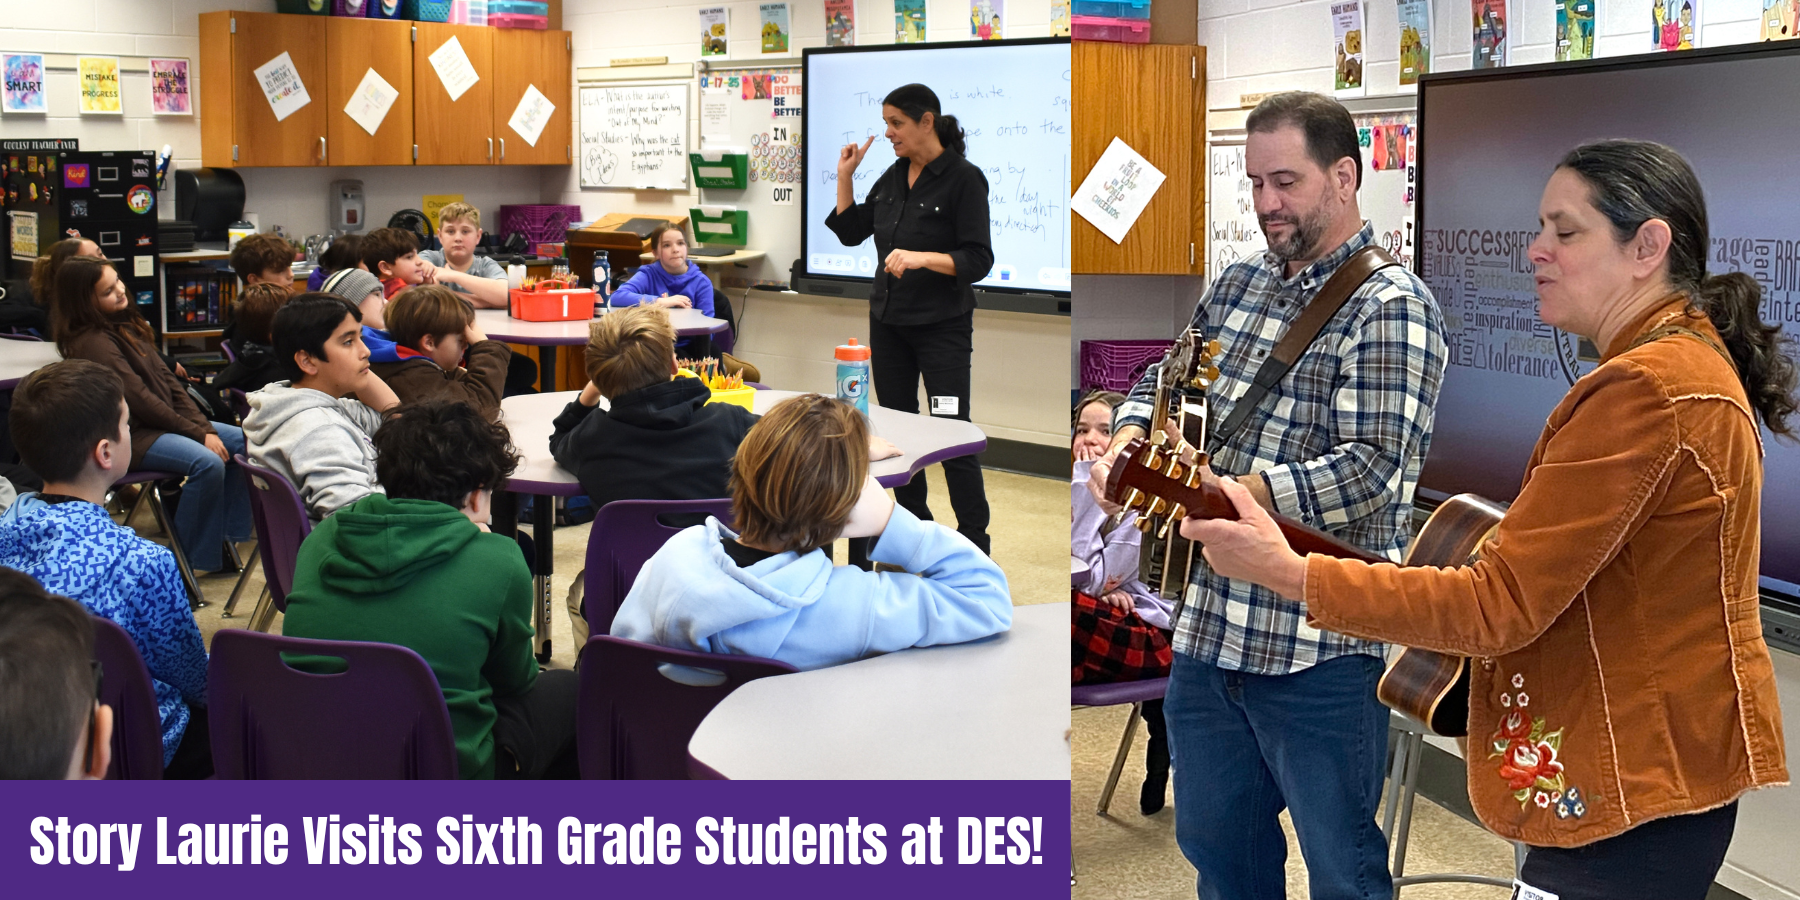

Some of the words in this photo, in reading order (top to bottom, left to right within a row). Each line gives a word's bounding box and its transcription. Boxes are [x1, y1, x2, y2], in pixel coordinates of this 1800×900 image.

[6, 81, 41, 91] SMART
[774, 86, 802, 95] BETTE
[606, 88, 623, 103] What
[633, 90, 643, 100] the
[774, 97, 785, 106] BE
[950, 89, 959, 100] is
[662, 104, 681, 116] writing
[774, 107, 802, 116] BETTE
[624, 117, 630, 126] of
[997, 120, 1028, 136] onto
[1040, 118, 1065, 134] the
[582, 132, 599, 144] Social
[601, 131, 623, 144] Studies
[631, 132, 645, 151] Why
[660, 134, 668, 144] the
[671, 133, 680, 144] cat
[774, 127, 786, 141] IN
[3, 141, 30, 150] COOLEST
[32, 141, 59, 150] TEACHER
[60, 141, 77, 150] EVER
[590, 154, 602, 167] Big
[639, 149, 664, 160] important
[598, 160, 614, 176] Ideas
[1127, 159, 1137, 170] BE
[1214, 153, 1230, 176] ELA
[67, 168, 86, 178] Kind
[1119, 164, 1140, 182] FRUIT
[1008, 162, 1025, 201] by
[1121, 176, 1137, 190] LOOP
[774, 188, 792, 201] OUT
[1104, 181, 1124, 201] WORLD
[1092, 194, 1120, 220] CHEERIOS
[1212, 221, 1229, 242] Social
[1230, 220, 1253, 242] Studies
[1437, 229, 1511, 257] success
[1707, 237, 1754, 273] rage
[562, 295, 568, 317] 1
[1478, 296, 1533, 310] accomplishment
[1769, 290, 1800, 323] Inte
[1463, 256, 1479, 367] dedication
[1475, 306, 1532, 335] inspiration
[1509, 336, 1555, 355] diverse
[1488, 342, 1558, 380] tolerance
